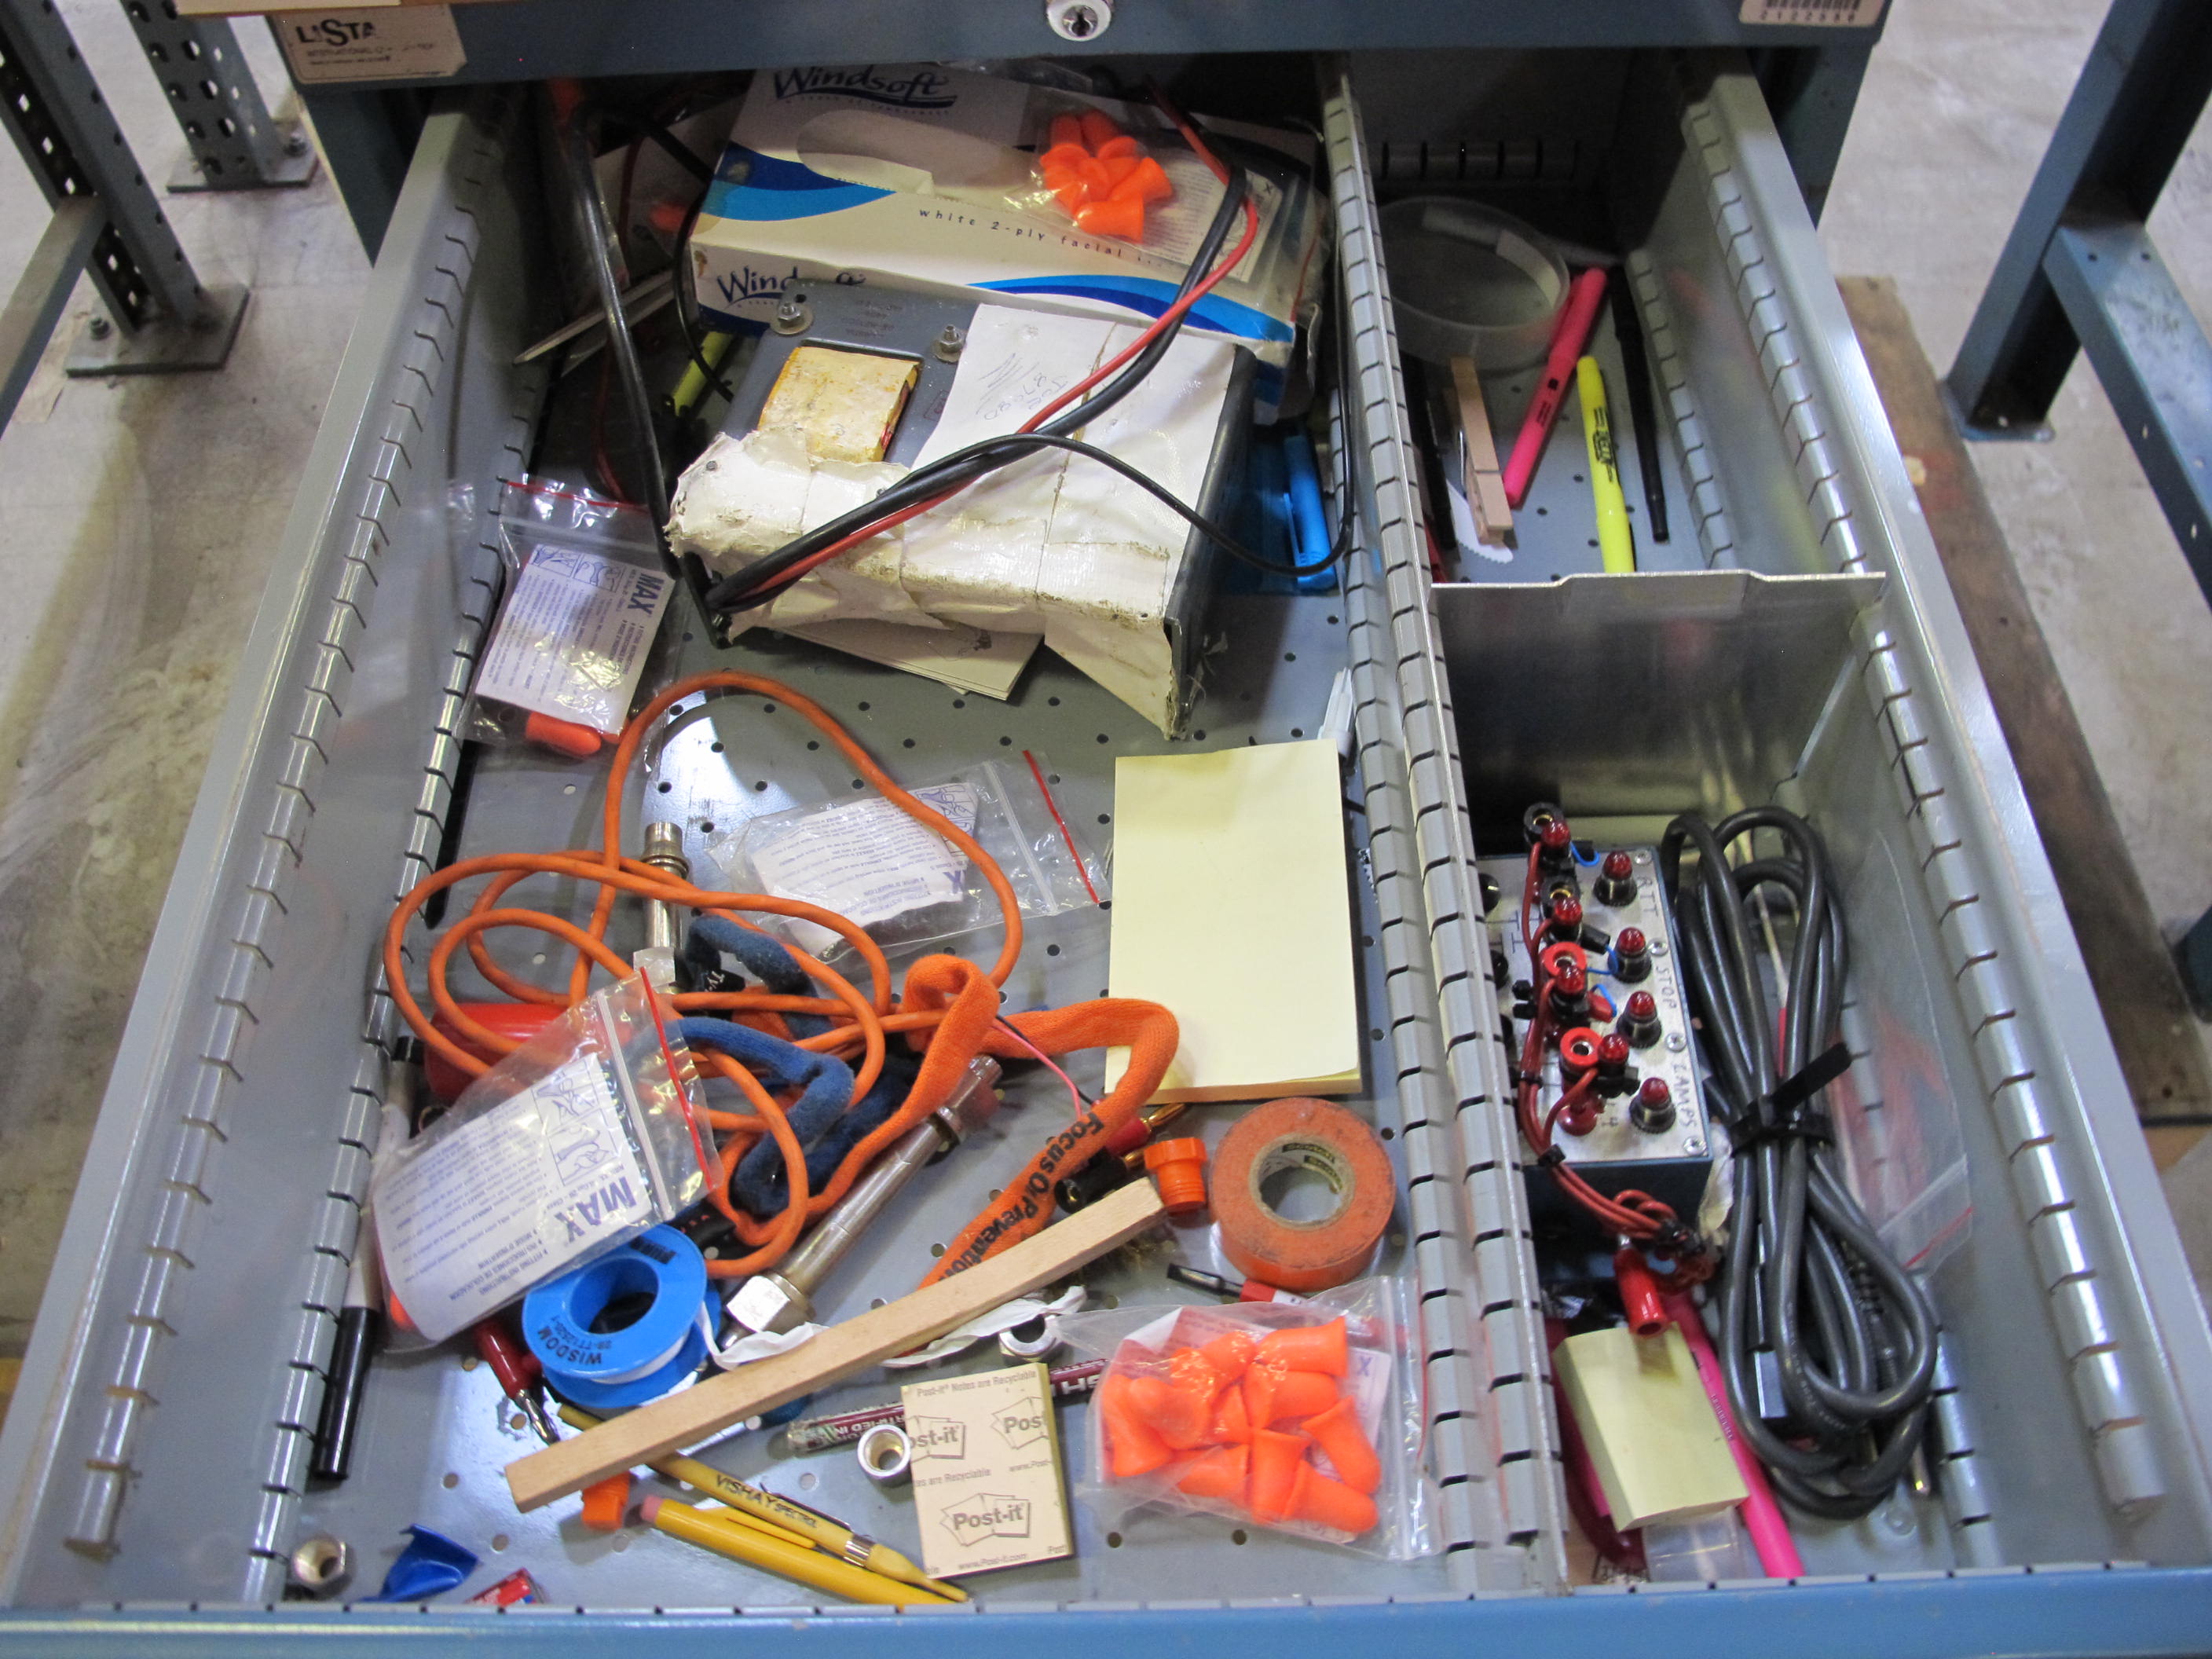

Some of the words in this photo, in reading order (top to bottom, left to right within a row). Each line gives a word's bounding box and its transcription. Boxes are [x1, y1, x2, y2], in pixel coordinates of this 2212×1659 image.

[774, 64, 950, 103] Windsoft
[919, 209, 975, 225] white
[991, 221, 1046, 240] 2-ply
[1061, 235, 1121, 257] facial
[628, 573, 665, 615] MAX
[1656, 966, 1676, 1009] STOP
[1672, 1063, 1697, 1127] LAMPS
[1039, 1112, 1104, 1173] Focus
[555, 1176, 638, 1243] MAX
[537, 1326, 602, 1364] WISDOM
[910, 1426, 958, 1448] ost-it
[1004, 1415, 1044, 1434] Pos
[716, 1474, 776, 1508] VISHAY
[954, 1503, 1024, 1531] Post-it
